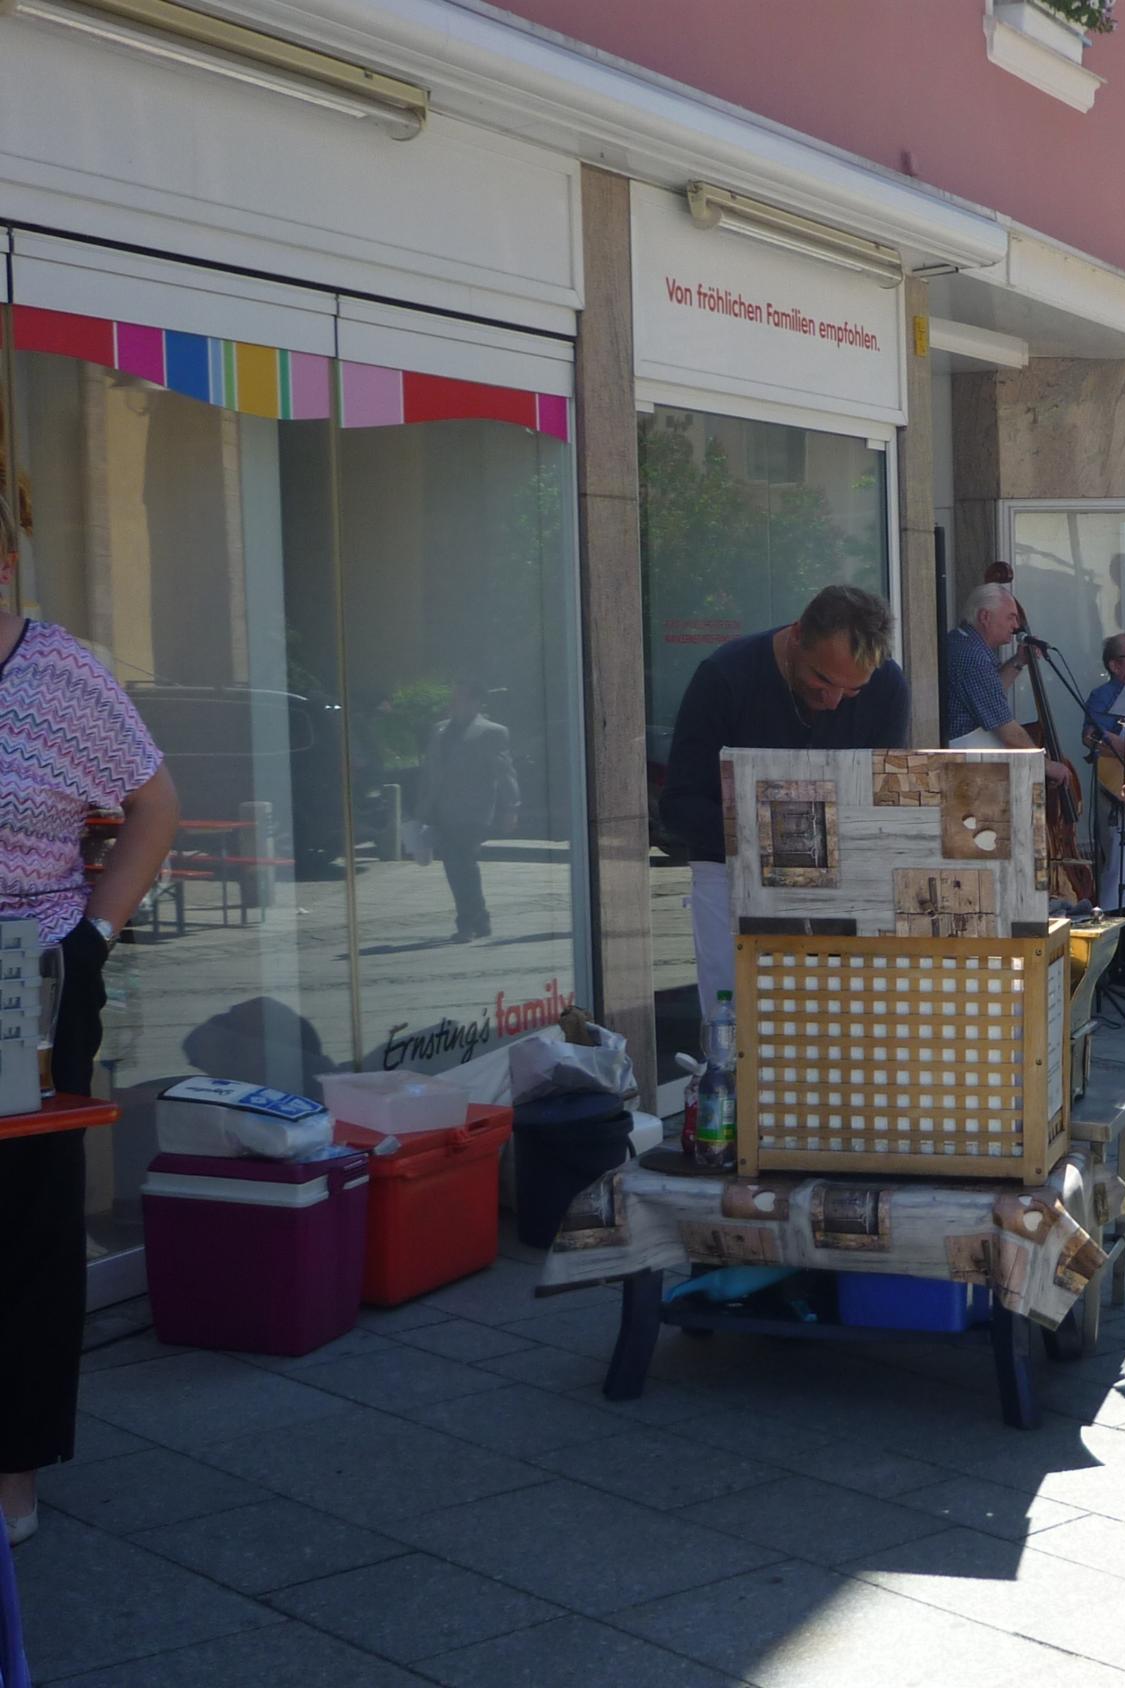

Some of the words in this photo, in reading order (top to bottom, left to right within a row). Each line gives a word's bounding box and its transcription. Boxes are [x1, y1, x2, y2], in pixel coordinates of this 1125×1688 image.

[665, 277, 692, 307] Von
[697, 283, 763, 323] fröhlichen
[766, 303, 816, 337] Familien
[819, 320, 881, 352] empfohlen.
[383, 1008, 491, 1072] Ernsting's
[495, 978, 576, 1039] family
